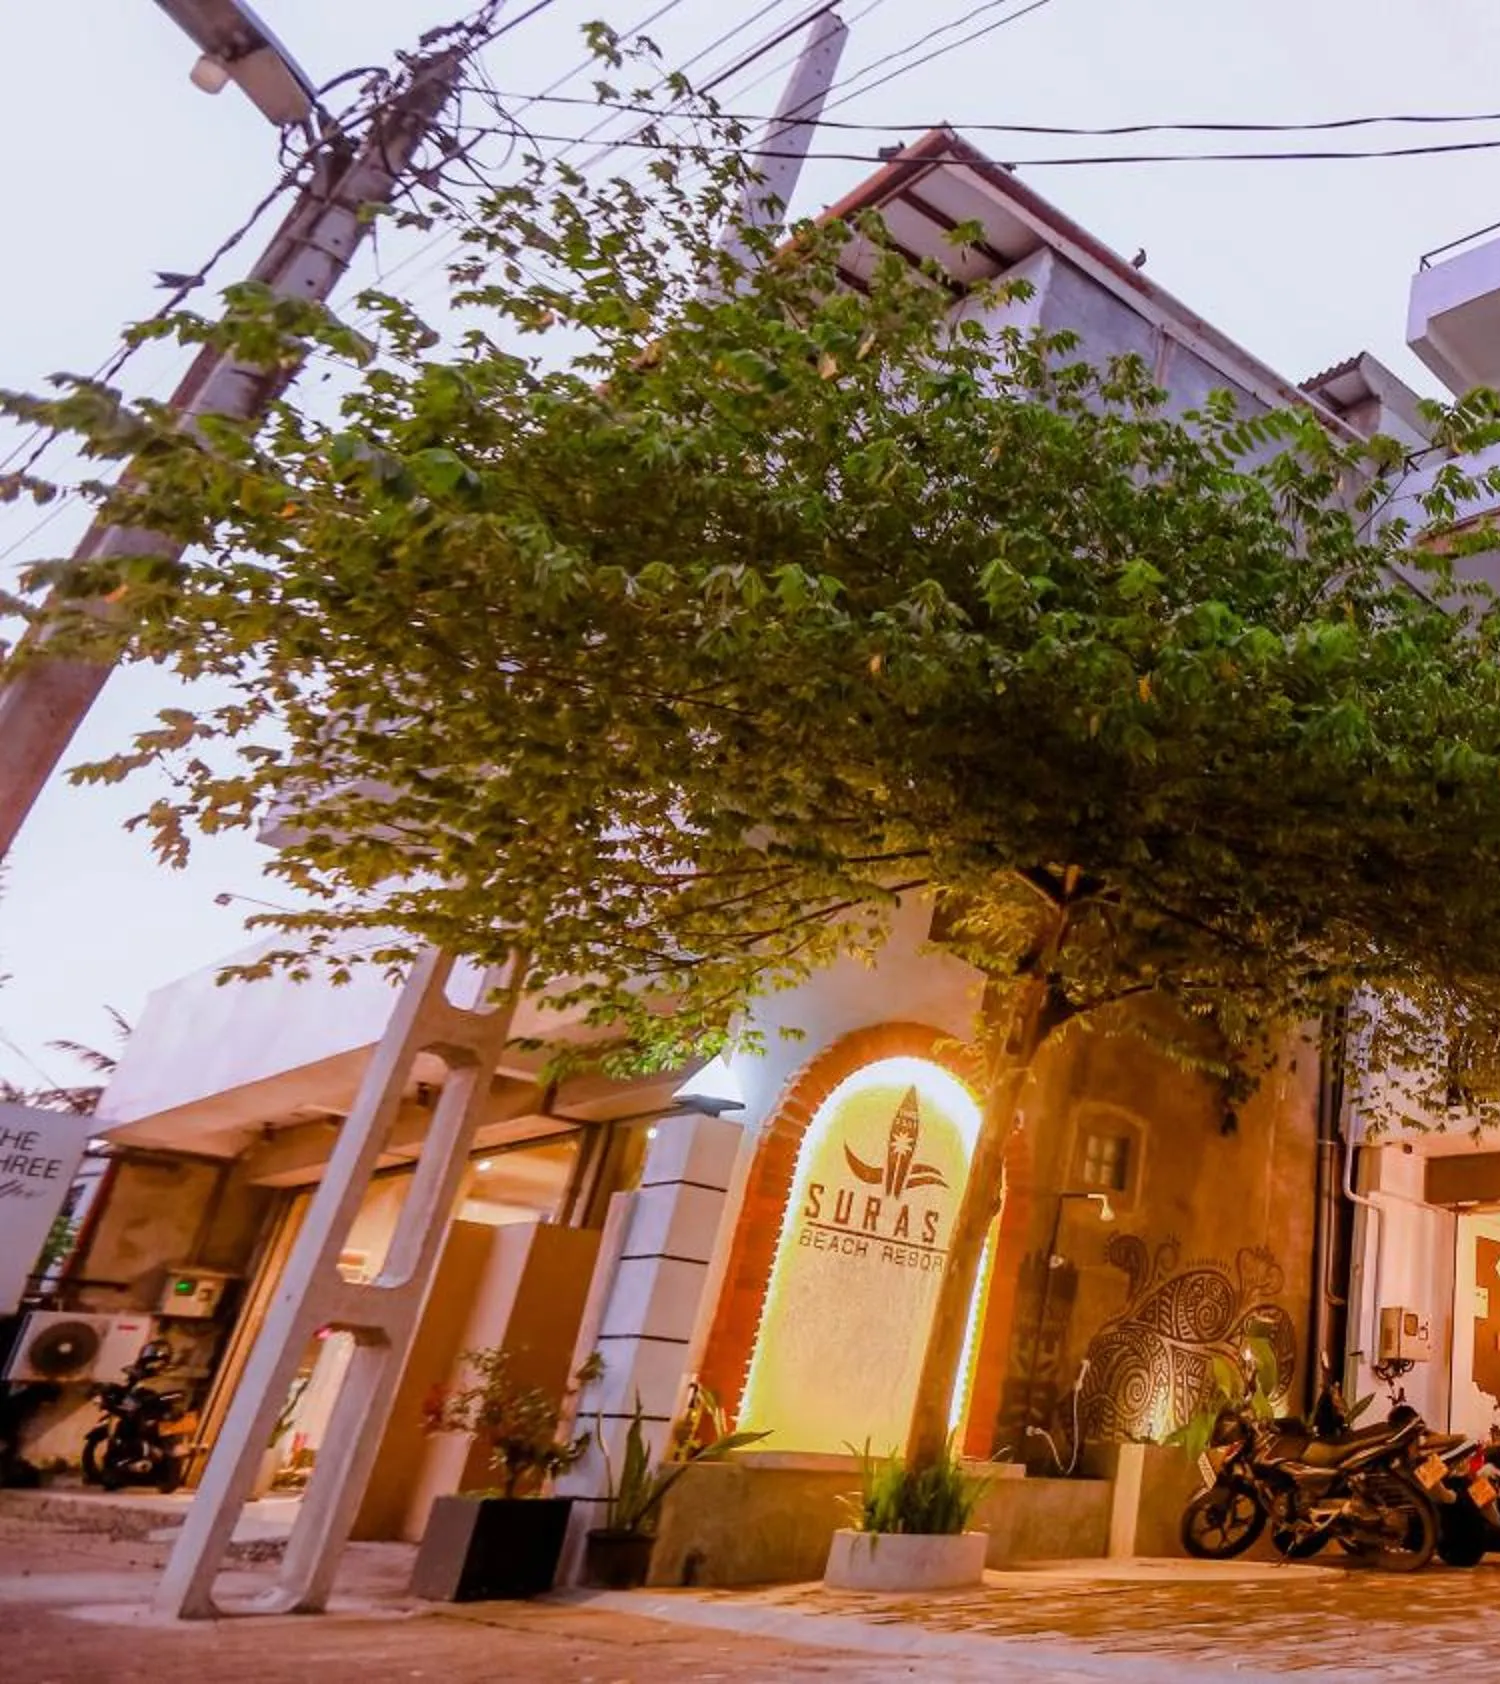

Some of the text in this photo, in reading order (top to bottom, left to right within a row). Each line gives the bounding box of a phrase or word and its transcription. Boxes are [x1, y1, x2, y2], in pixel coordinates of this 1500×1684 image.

[0, 1127, 42, 1151] HE
[0, 1154, 63, 1179] HREE
[804, 1183, 940, 1244] SURAS
[799, 1229, 944, 1272] BEACH RESOR
